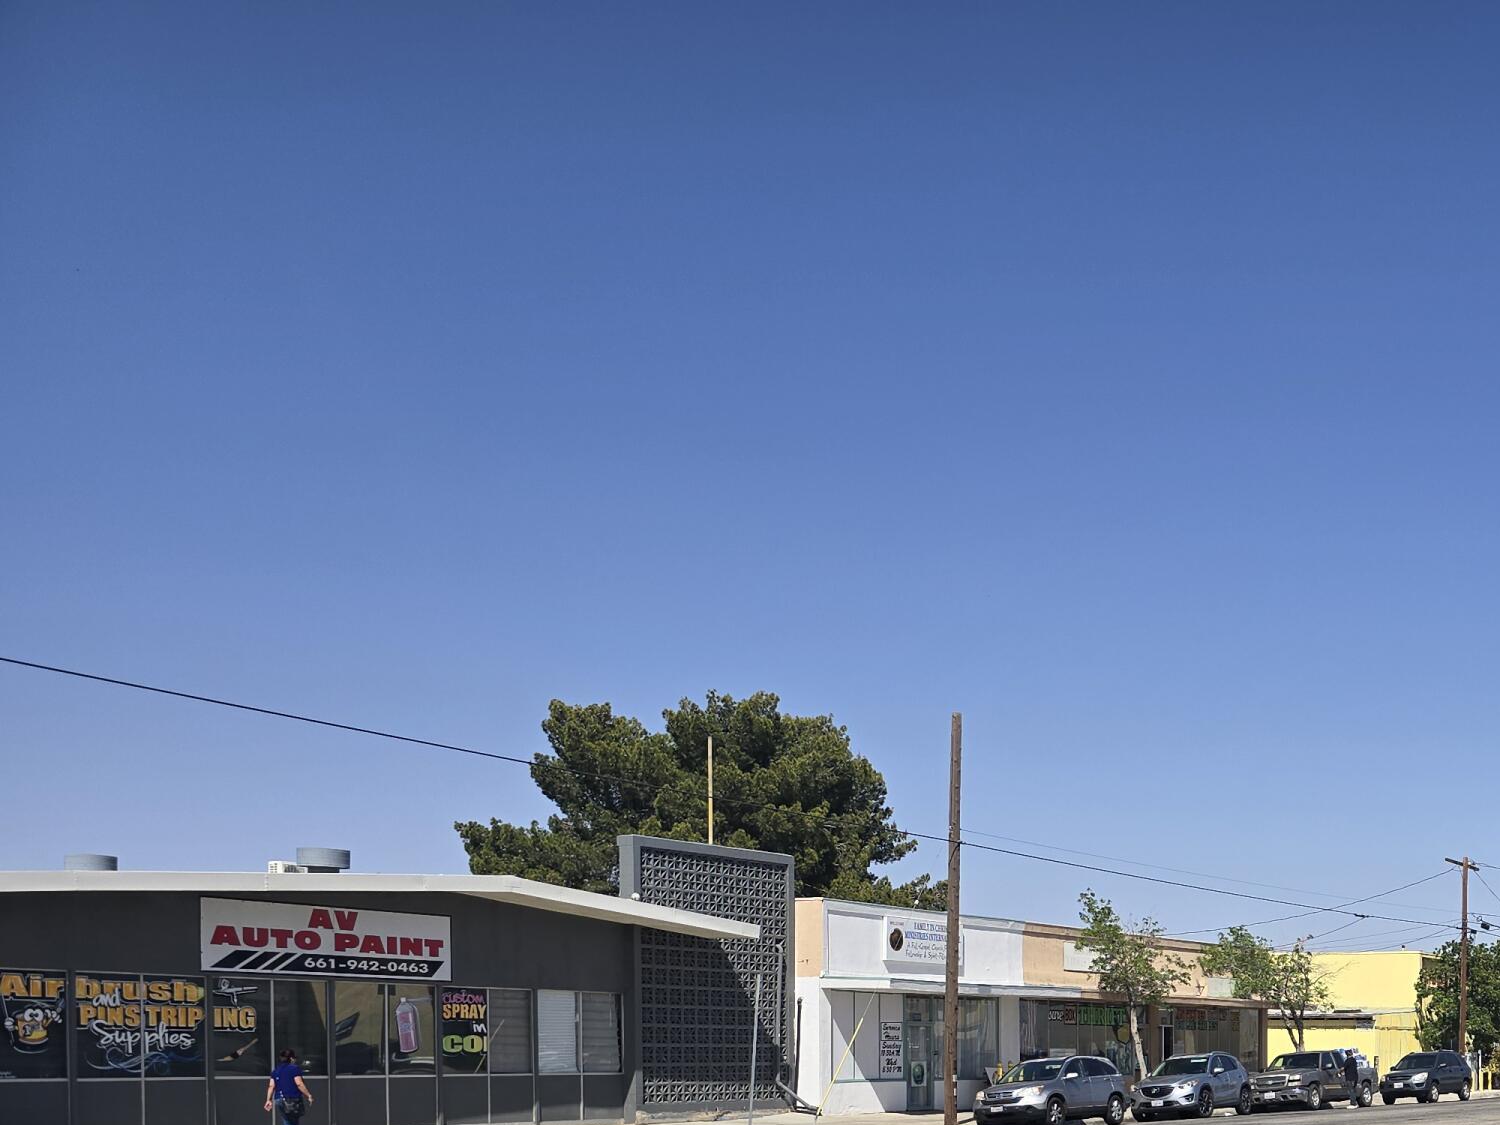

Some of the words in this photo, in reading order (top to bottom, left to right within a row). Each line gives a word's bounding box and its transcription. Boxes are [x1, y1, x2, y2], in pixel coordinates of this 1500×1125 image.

[308, 908, 359, 931] AV
[210, 925, 322, 950] AUTO
[334, 932, 444, 957] PAINT
[304, 956, 429, 974] 661-942-0463
[1, 973, 64, 998] Air
[93, 988, 121, 1007] and
[443, 1004, 487, 1019] SPRAY
[90, 1018, 193, 1054] Supplies
